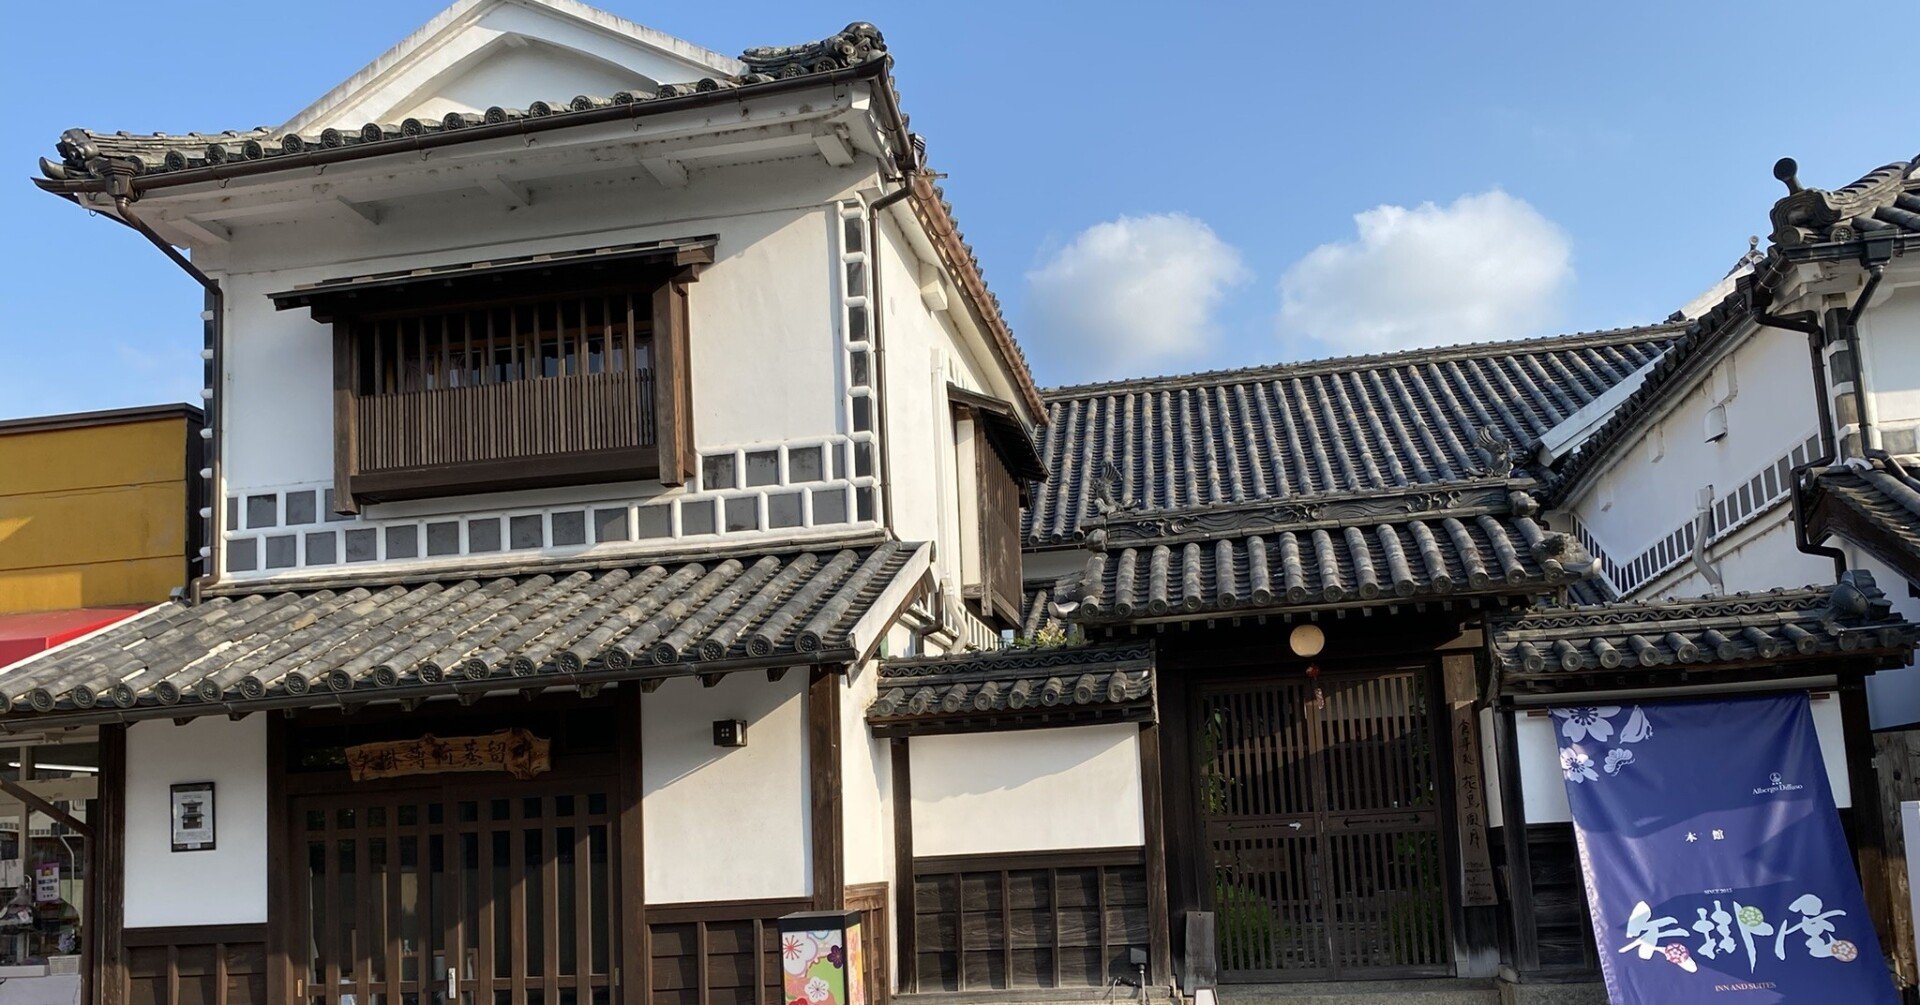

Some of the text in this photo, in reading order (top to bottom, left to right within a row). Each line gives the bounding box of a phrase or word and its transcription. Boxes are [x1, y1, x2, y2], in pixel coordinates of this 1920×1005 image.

[1752, 787, 1778, 795] Albergo
[1461, 775, 1482, 849] 花鳥風月
[1685, 829, 1724, 842] 本館
[1618, 893, 1858, 975] 矢掛屋
[1714, 982, 1777, 992] INN AND SUITES
